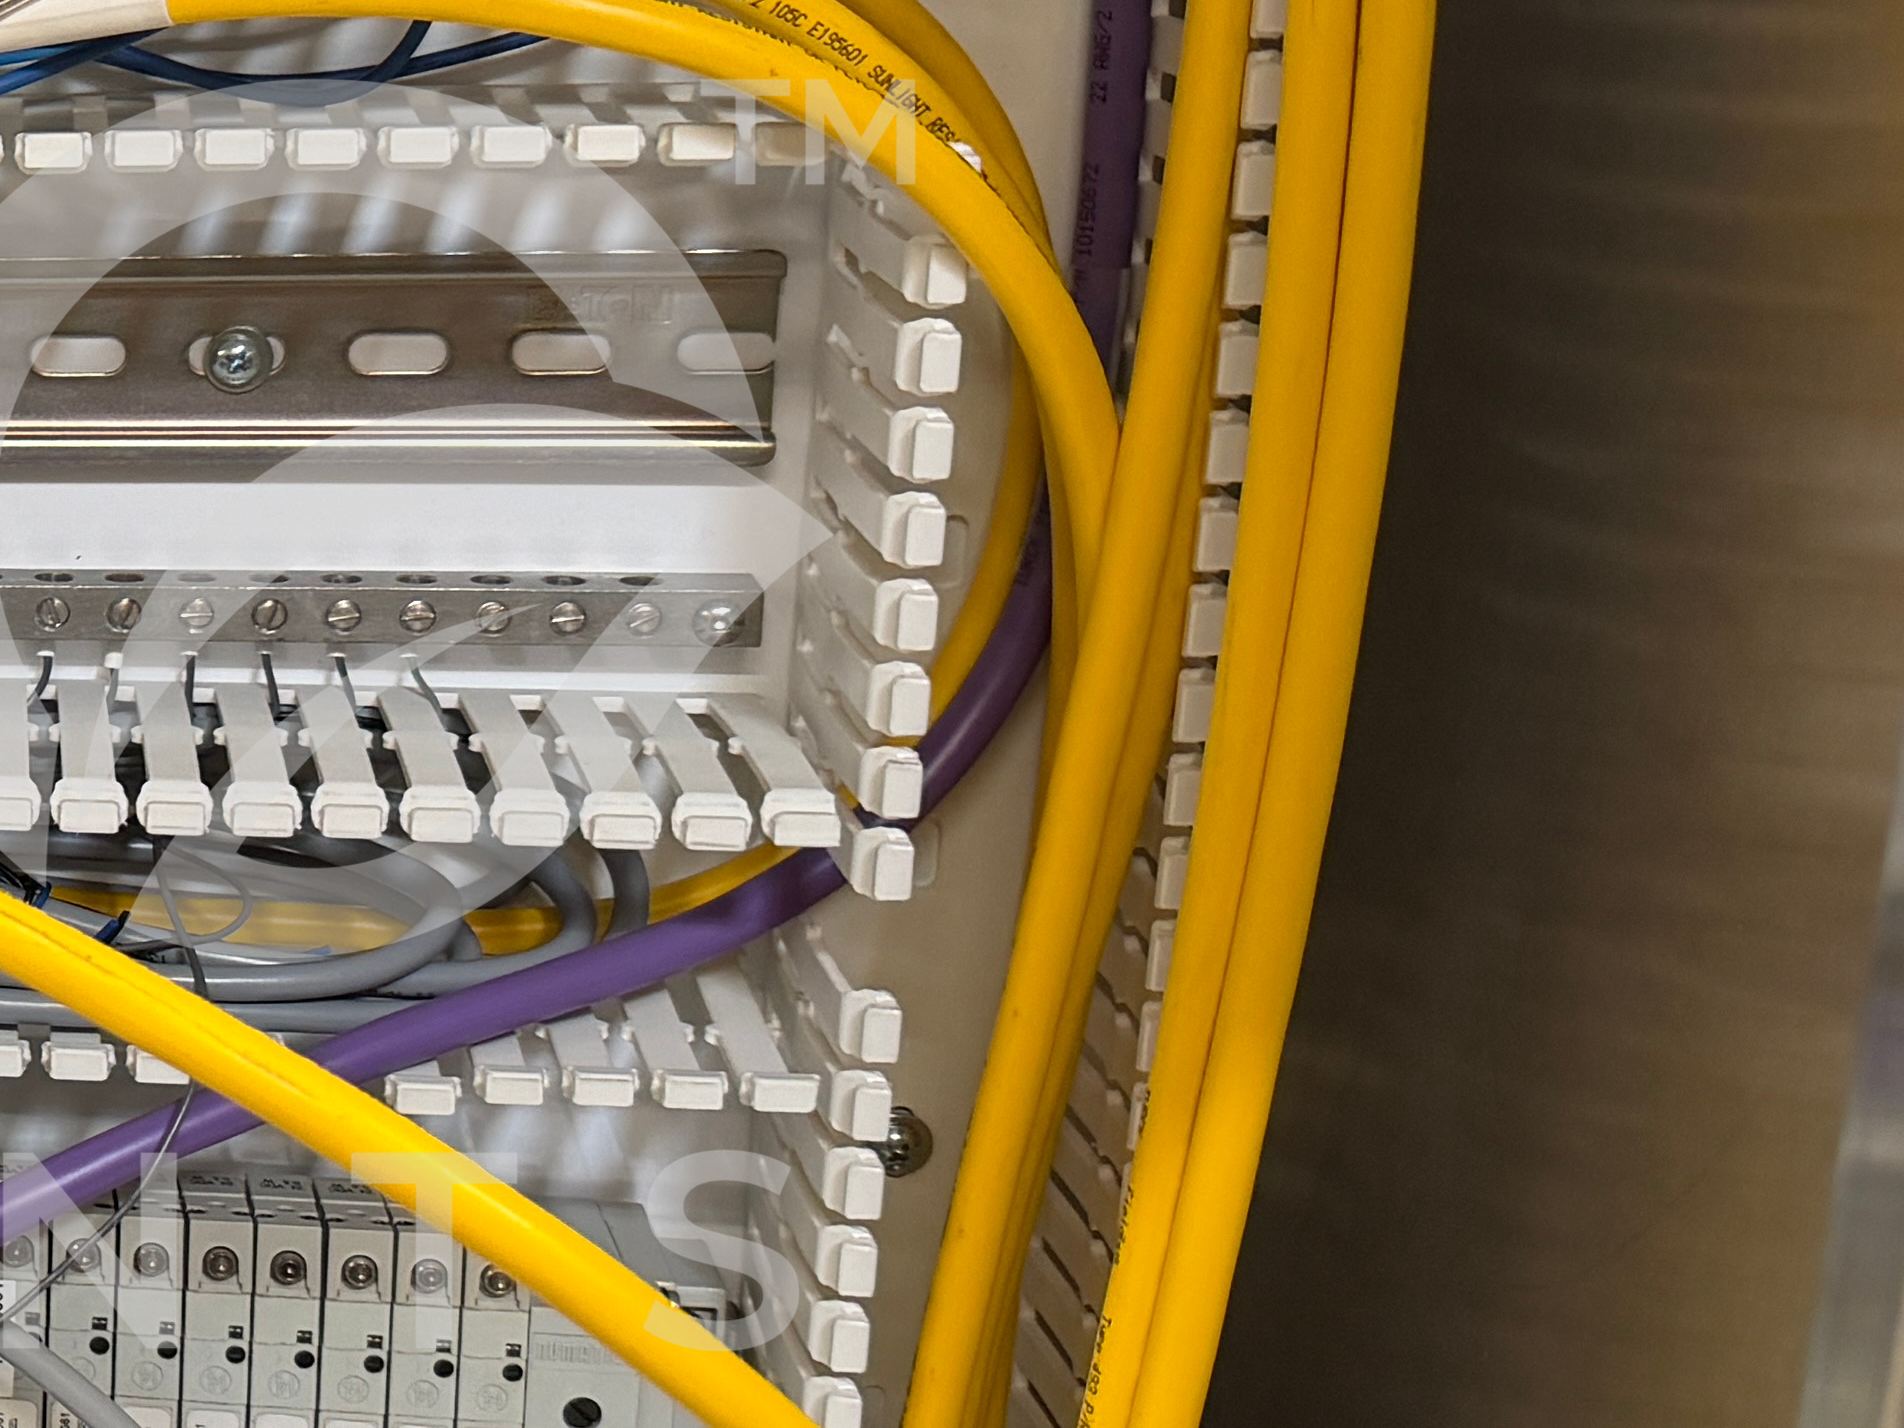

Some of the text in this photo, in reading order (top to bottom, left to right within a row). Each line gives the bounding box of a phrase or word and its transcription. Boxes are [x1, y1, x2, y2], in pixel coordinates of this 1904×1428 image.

[769, 0, 807, 27] 105C
[807, 22, 869, 66] E195601
[867, 64, 930, 127] SUNLIGHT
